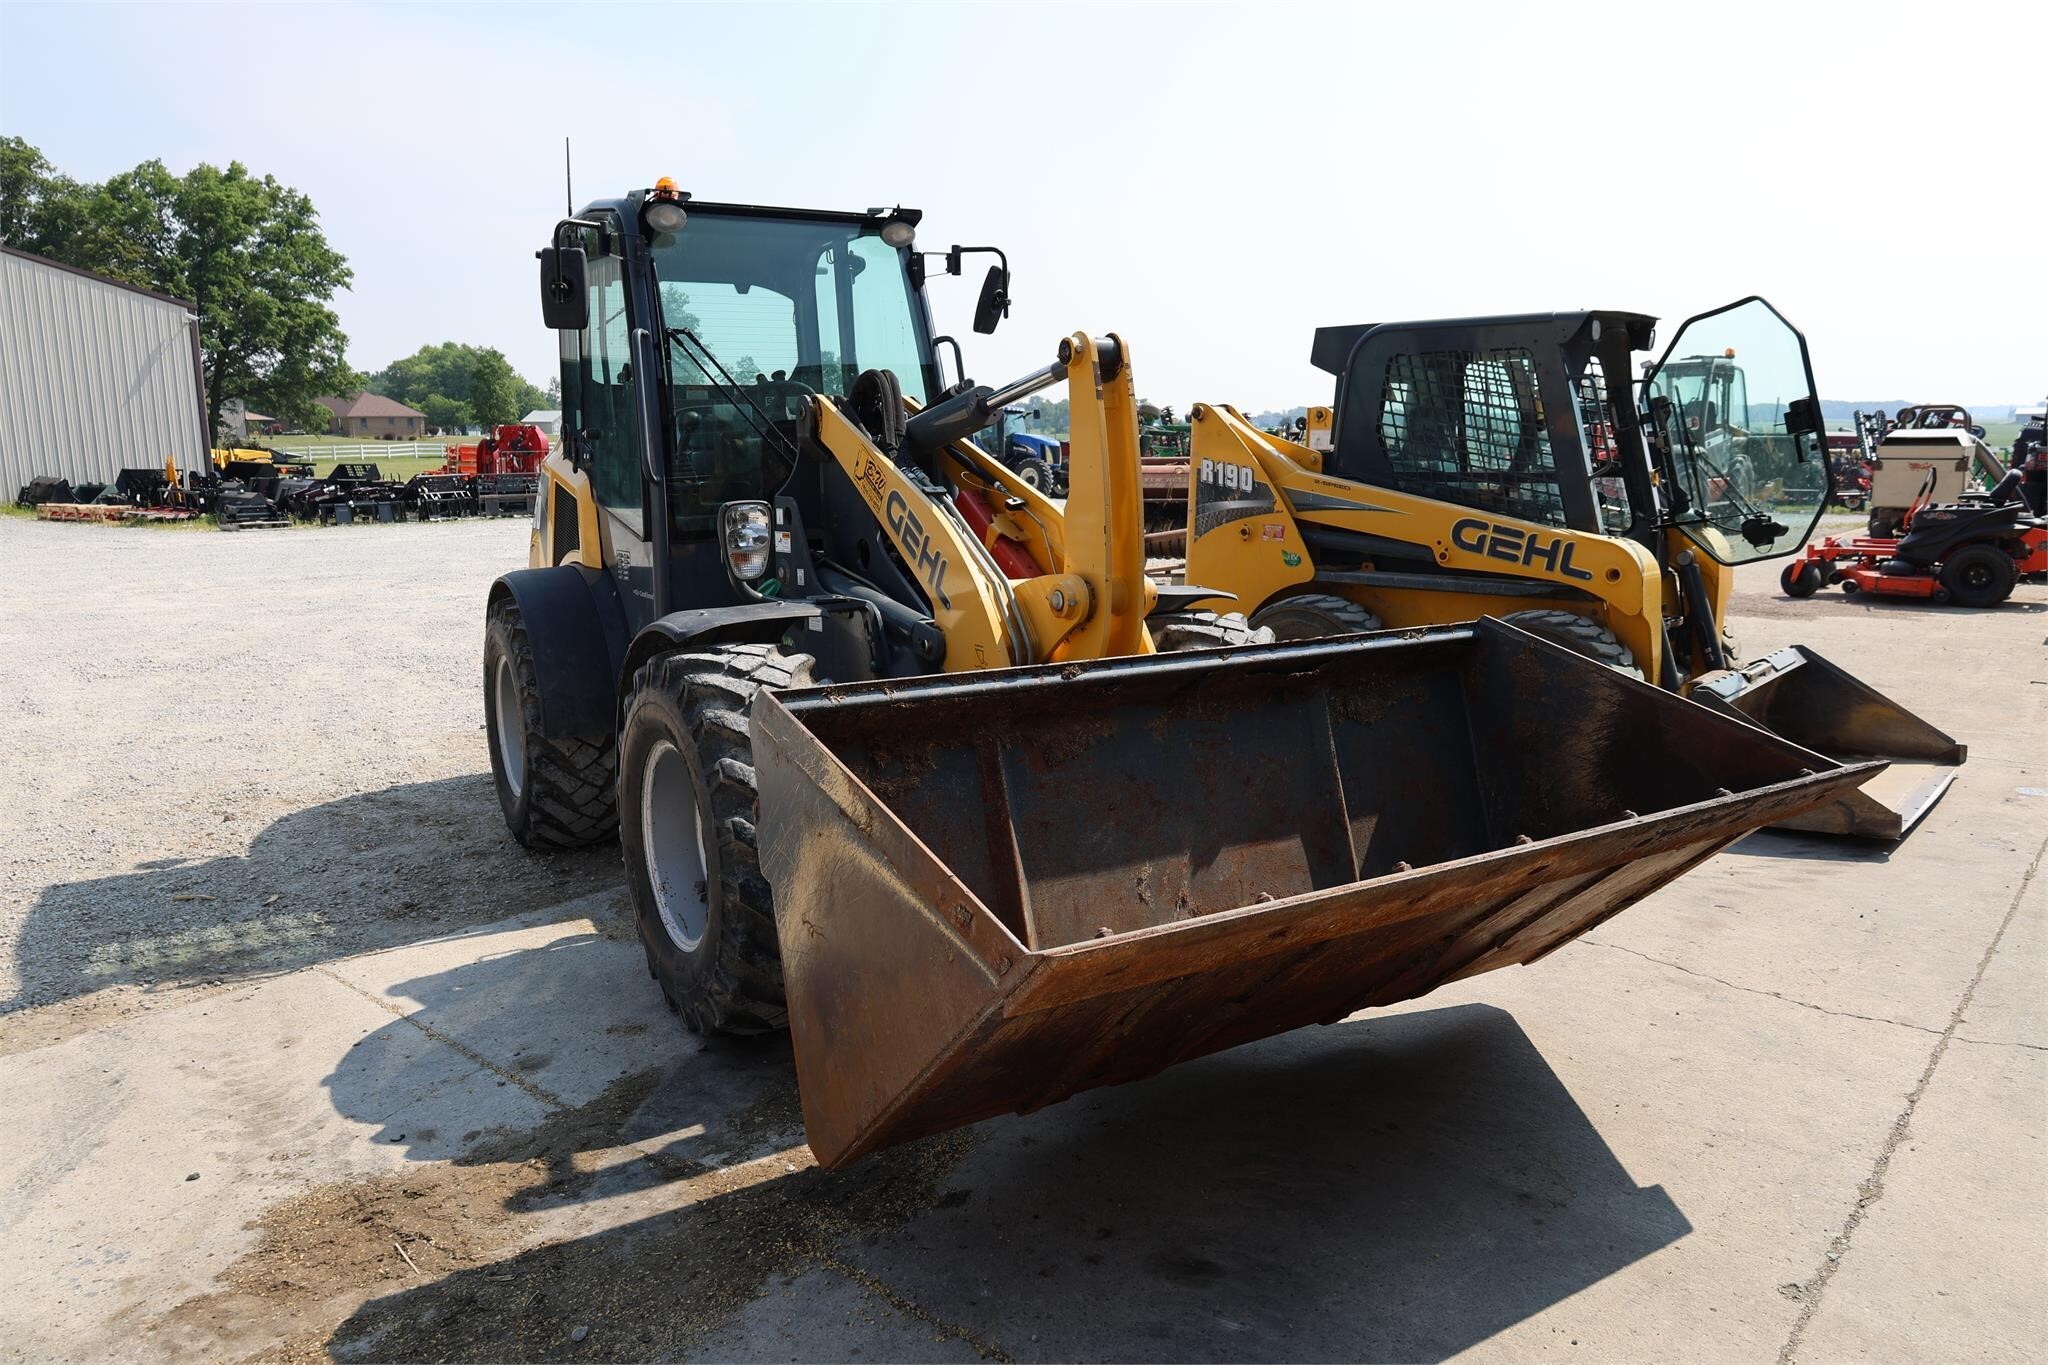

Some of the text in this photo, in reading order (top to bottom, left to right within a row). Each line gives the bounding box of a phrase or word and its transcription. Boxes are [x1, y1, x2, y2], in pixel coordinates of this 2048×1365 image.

[1201, 458, 1254, 493] R190
[886, 490, 951, 611] GEHL
[1451, 518, 1593, 581] GEHL
